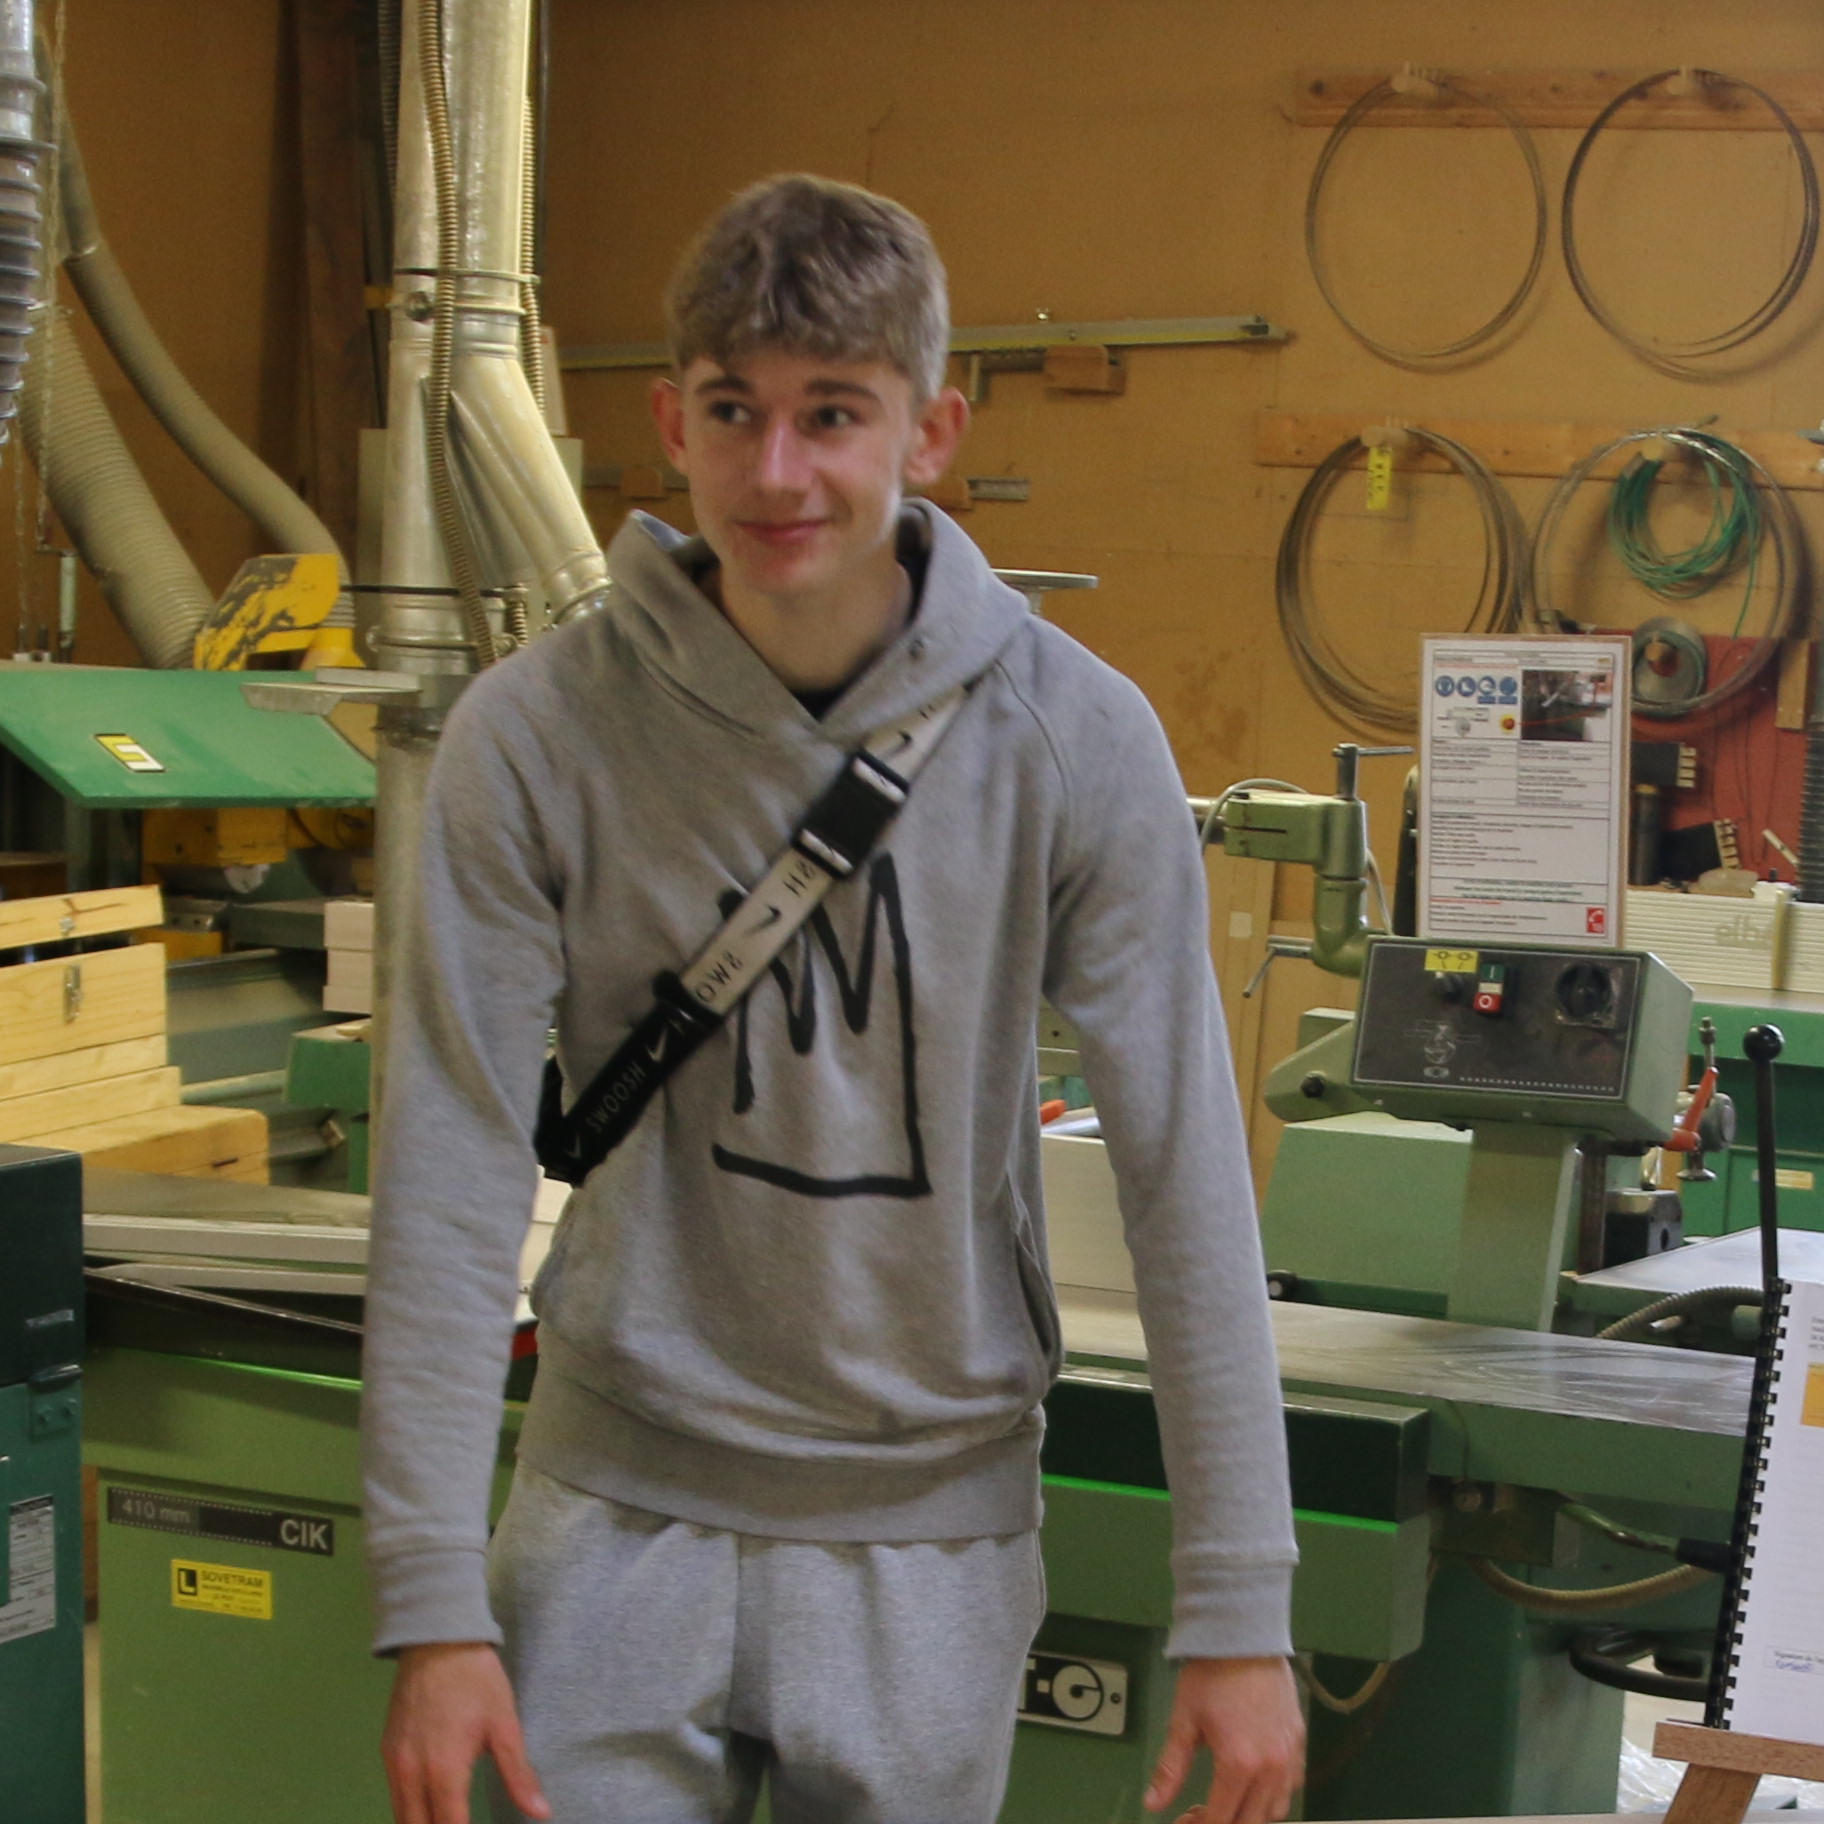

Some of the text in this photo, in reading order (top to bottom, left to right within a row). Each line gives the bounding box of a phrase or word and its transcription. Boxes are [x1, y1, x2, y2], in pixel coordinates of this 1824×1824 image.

[584, 1061, 648, 1134] SWOOSH
[122, 1499, 330, 1549] 410 mm CIK
[200, 1570, 264, 1588] SOVETRAM
